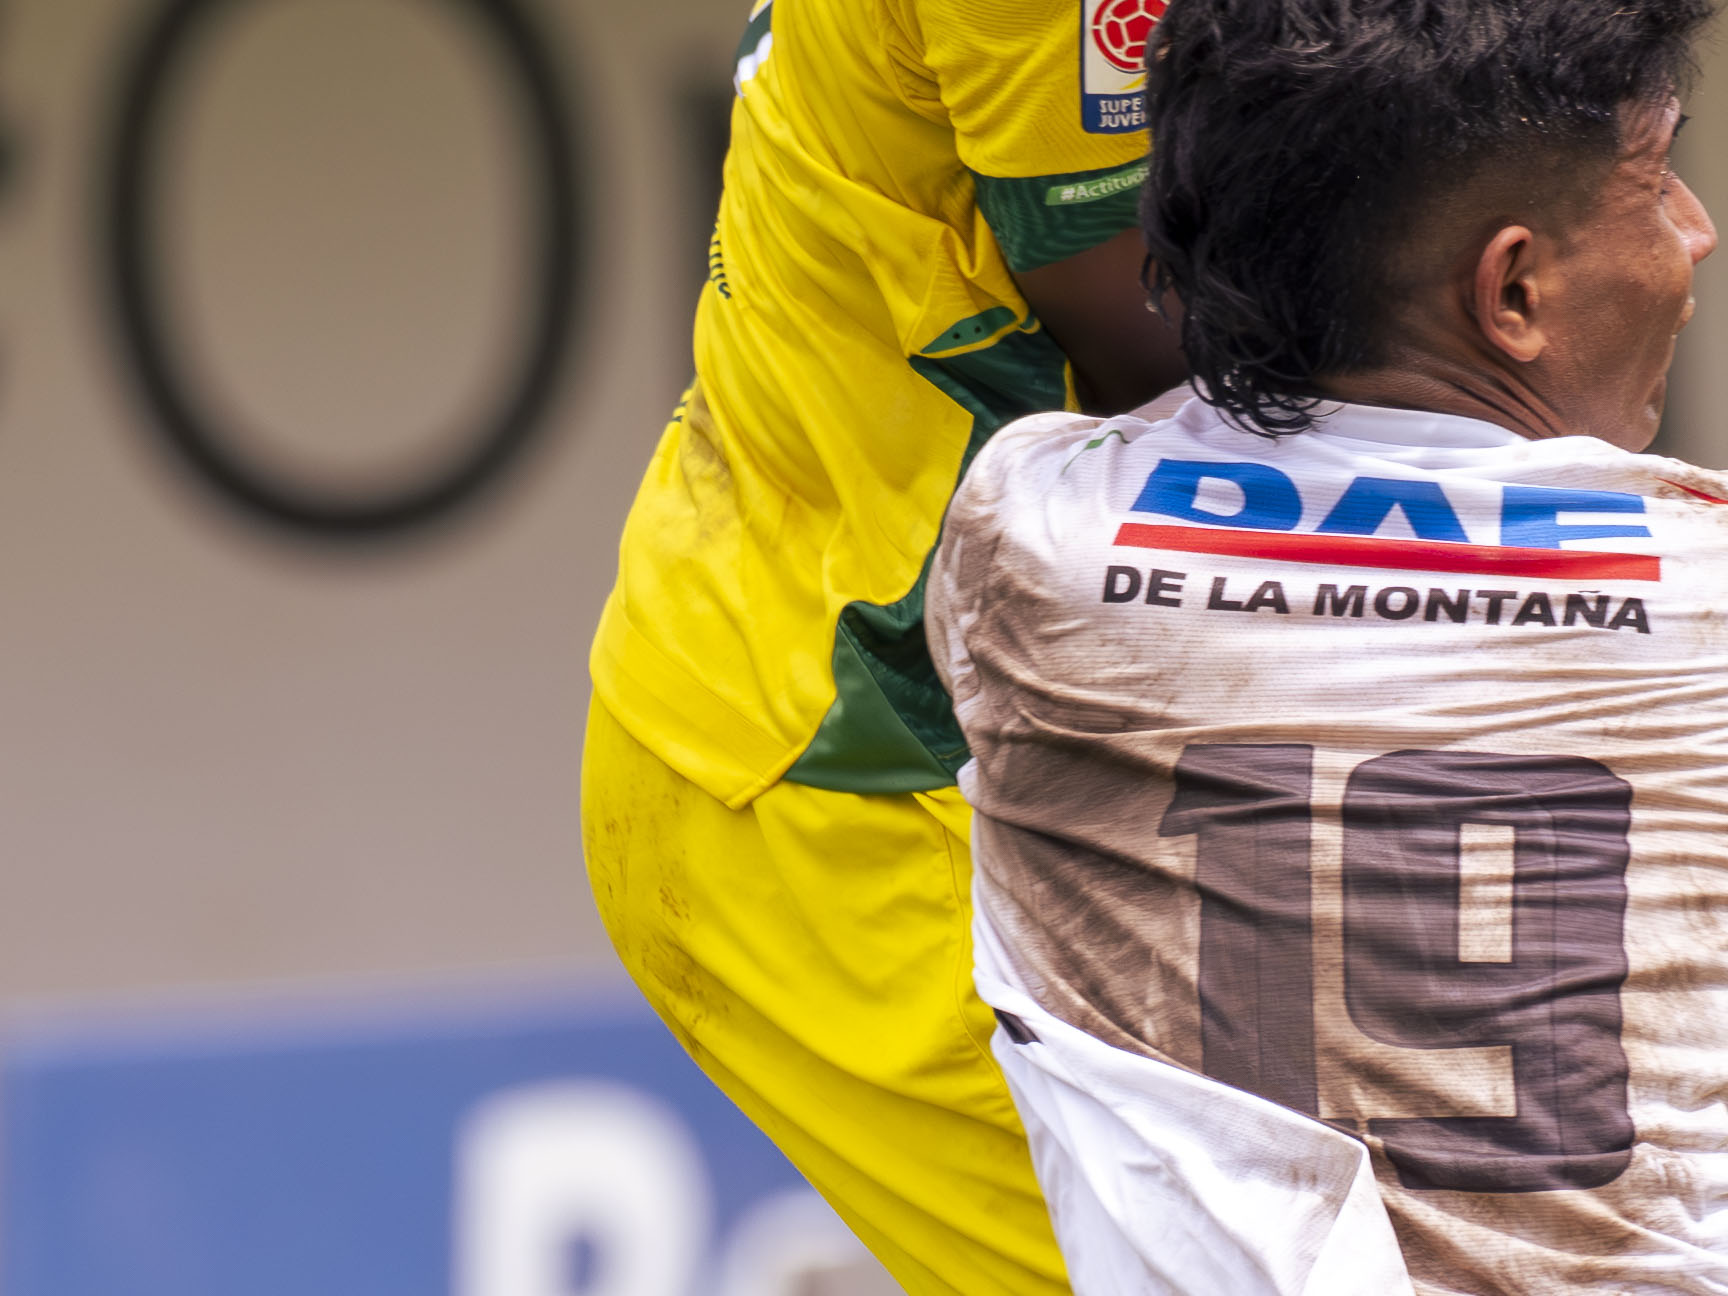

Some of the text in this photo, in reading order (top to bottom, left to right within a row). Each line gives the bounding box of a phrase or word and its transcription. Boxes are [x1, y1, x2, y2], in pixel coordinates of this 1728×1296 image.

[1099, 97, 1143, 112] SUPE
[1130, 458, 1653, 550] DAF
[1102, 565, 1652, 634] DE LA MONTAÑA
[1157, 743, 1634, 1192] 19
